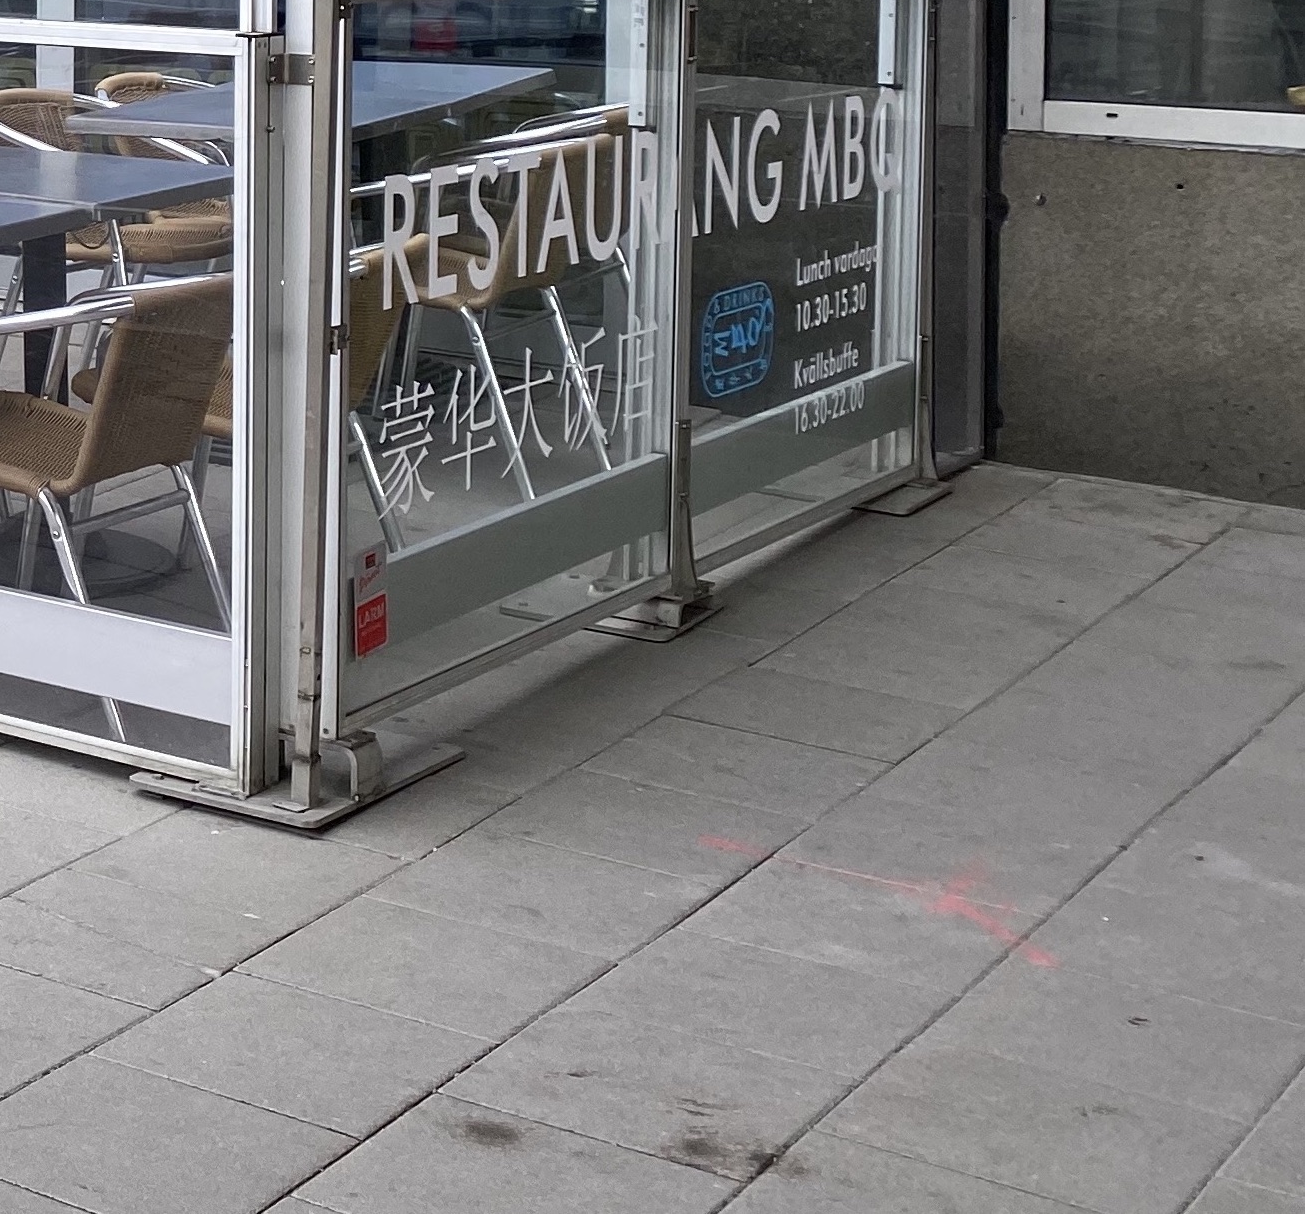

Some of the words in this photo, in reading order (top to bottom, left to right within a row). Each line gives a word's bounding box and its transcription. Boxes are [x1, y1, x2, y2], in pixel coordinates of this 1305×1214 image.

[382, 109, 783, 311] RESTAURNG
[799, 86, 901, 212] MBQ
[795, 249, 832, 286] Lunch
[795, 282, 868, 333] 10.30-15.30
[376, 326, 659, 518] 蒙华大饭店
[794, 380, 866, 436] 16.30-22.00
